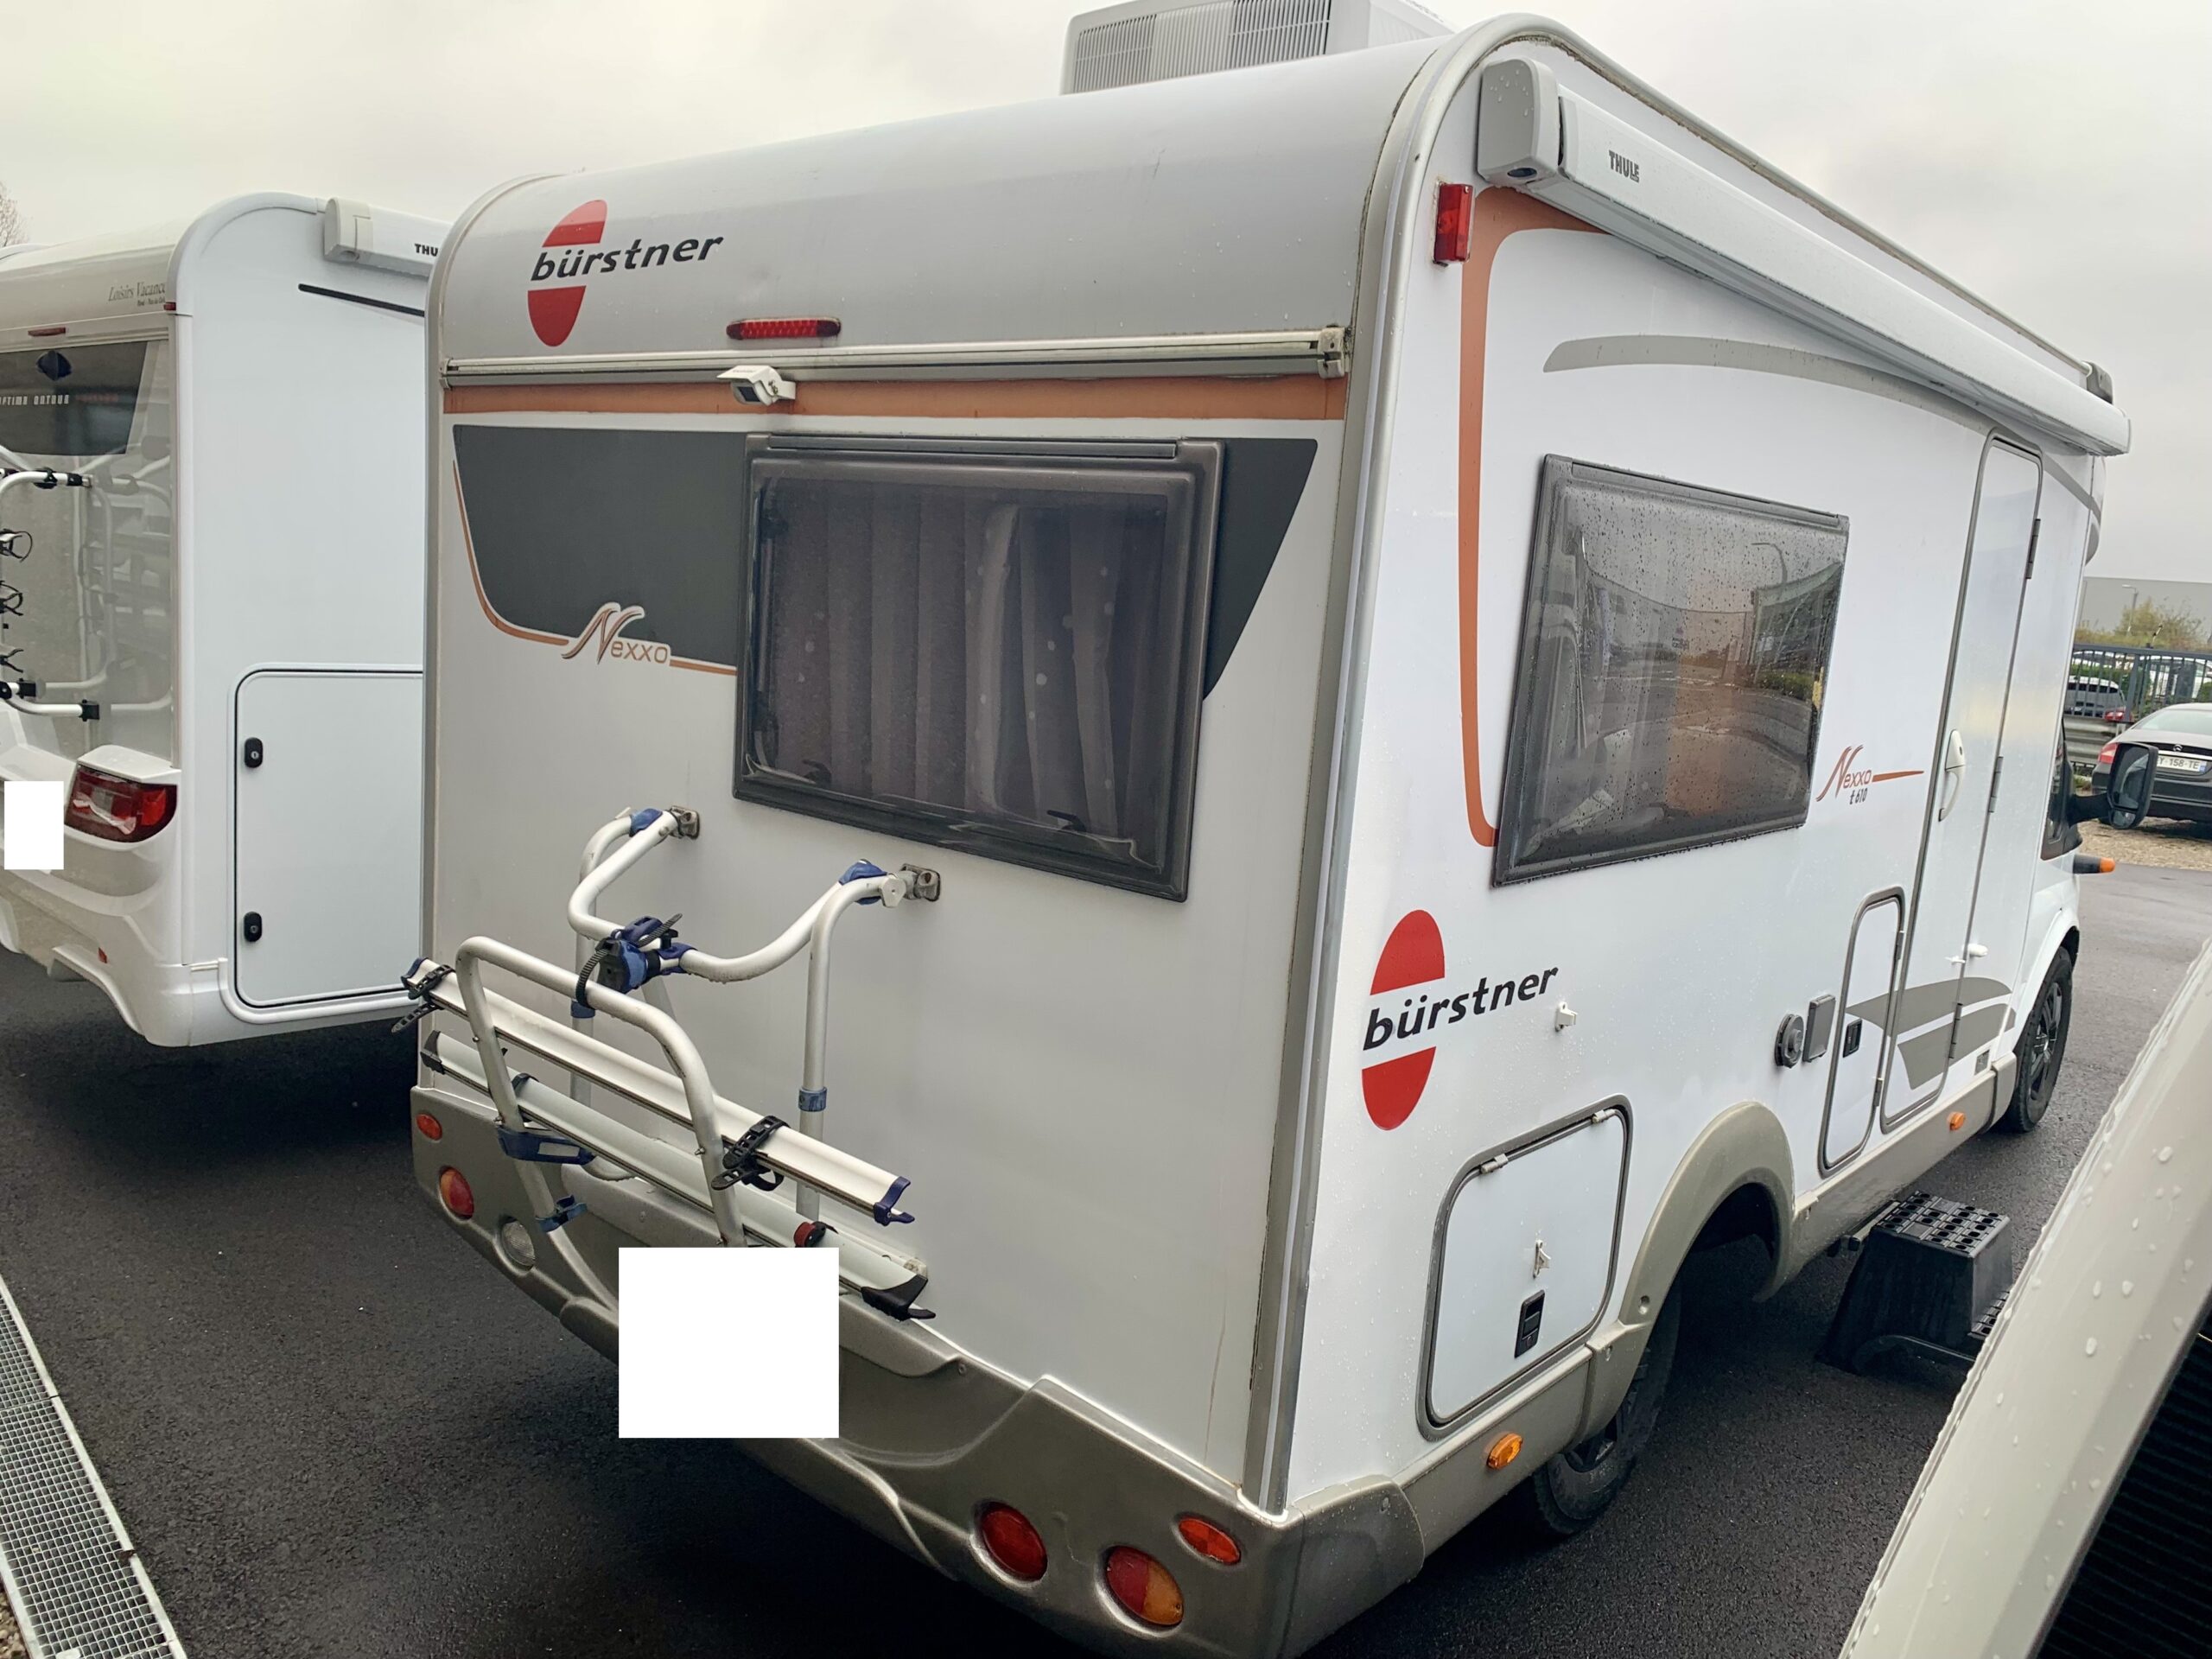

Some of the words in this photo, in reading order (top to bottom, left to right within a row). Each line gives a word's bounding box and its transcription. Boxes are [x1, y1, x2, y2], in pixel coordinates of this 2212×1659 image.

[1609, 149, 1639, 183] THULE
[414, 243, 439, 257] THU
[531, 237, 724, 282] bürstner
[561, 607, 669, 665] Nexxo
[1815, 744, 1872, 802] Nexxo
[2158, 757, 2201, 770] Y-158-TE
[1363, 966, 1559, 1052] bürstner
